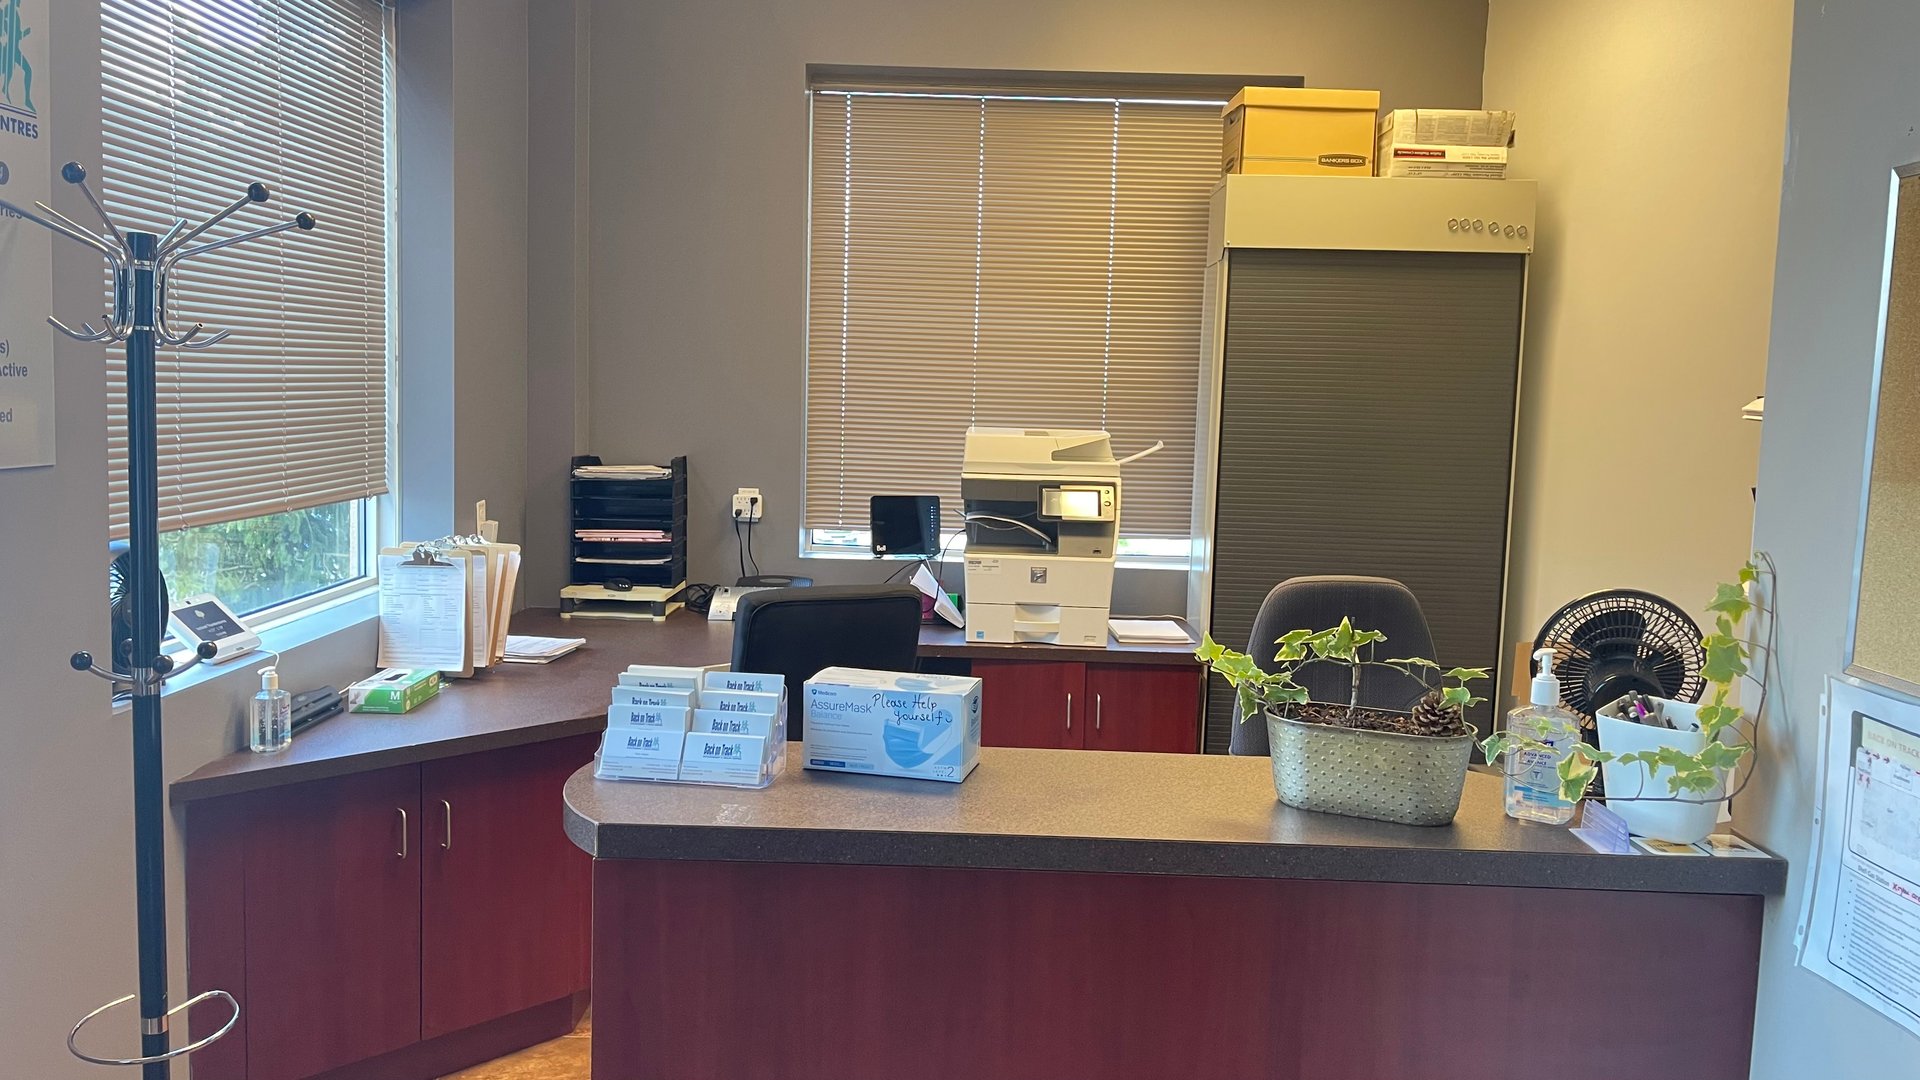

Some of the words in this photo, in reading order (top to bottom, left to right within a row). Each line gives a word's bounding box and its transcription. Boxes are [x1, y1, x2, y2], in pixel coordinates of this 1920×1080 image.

[0, 115, 38, 139] NTRES
[726, 680, 737, 690] Back
[744, 681, 755, 691] Track
[390, 690, 400, 700] M
[720, 701, 730, 711] Back
[737, 702, 748, 712] Track
[810, 698, 872, 714] AssureMask
[872, 693, 908, 708] Please
[912, 693, 938, 712] Help
[630, 712, 640, 722] Back
[640, 714, 646, 722] on
[646, 712, 656, 723] Track
[712, 718, 723, 731] Back
[723, 722, 729, 732] on
[729, 720, 740, 732] Track
[628, 736, 638, 747] Back
[637, 740, 642, 748] on
[642, 737, 653, 748] Track
[704, 743, 715, 755] Back
[715, 746, 721, 756] on
[721, 744, 734, 756] Track
[948, 766, 954, 778] 2
